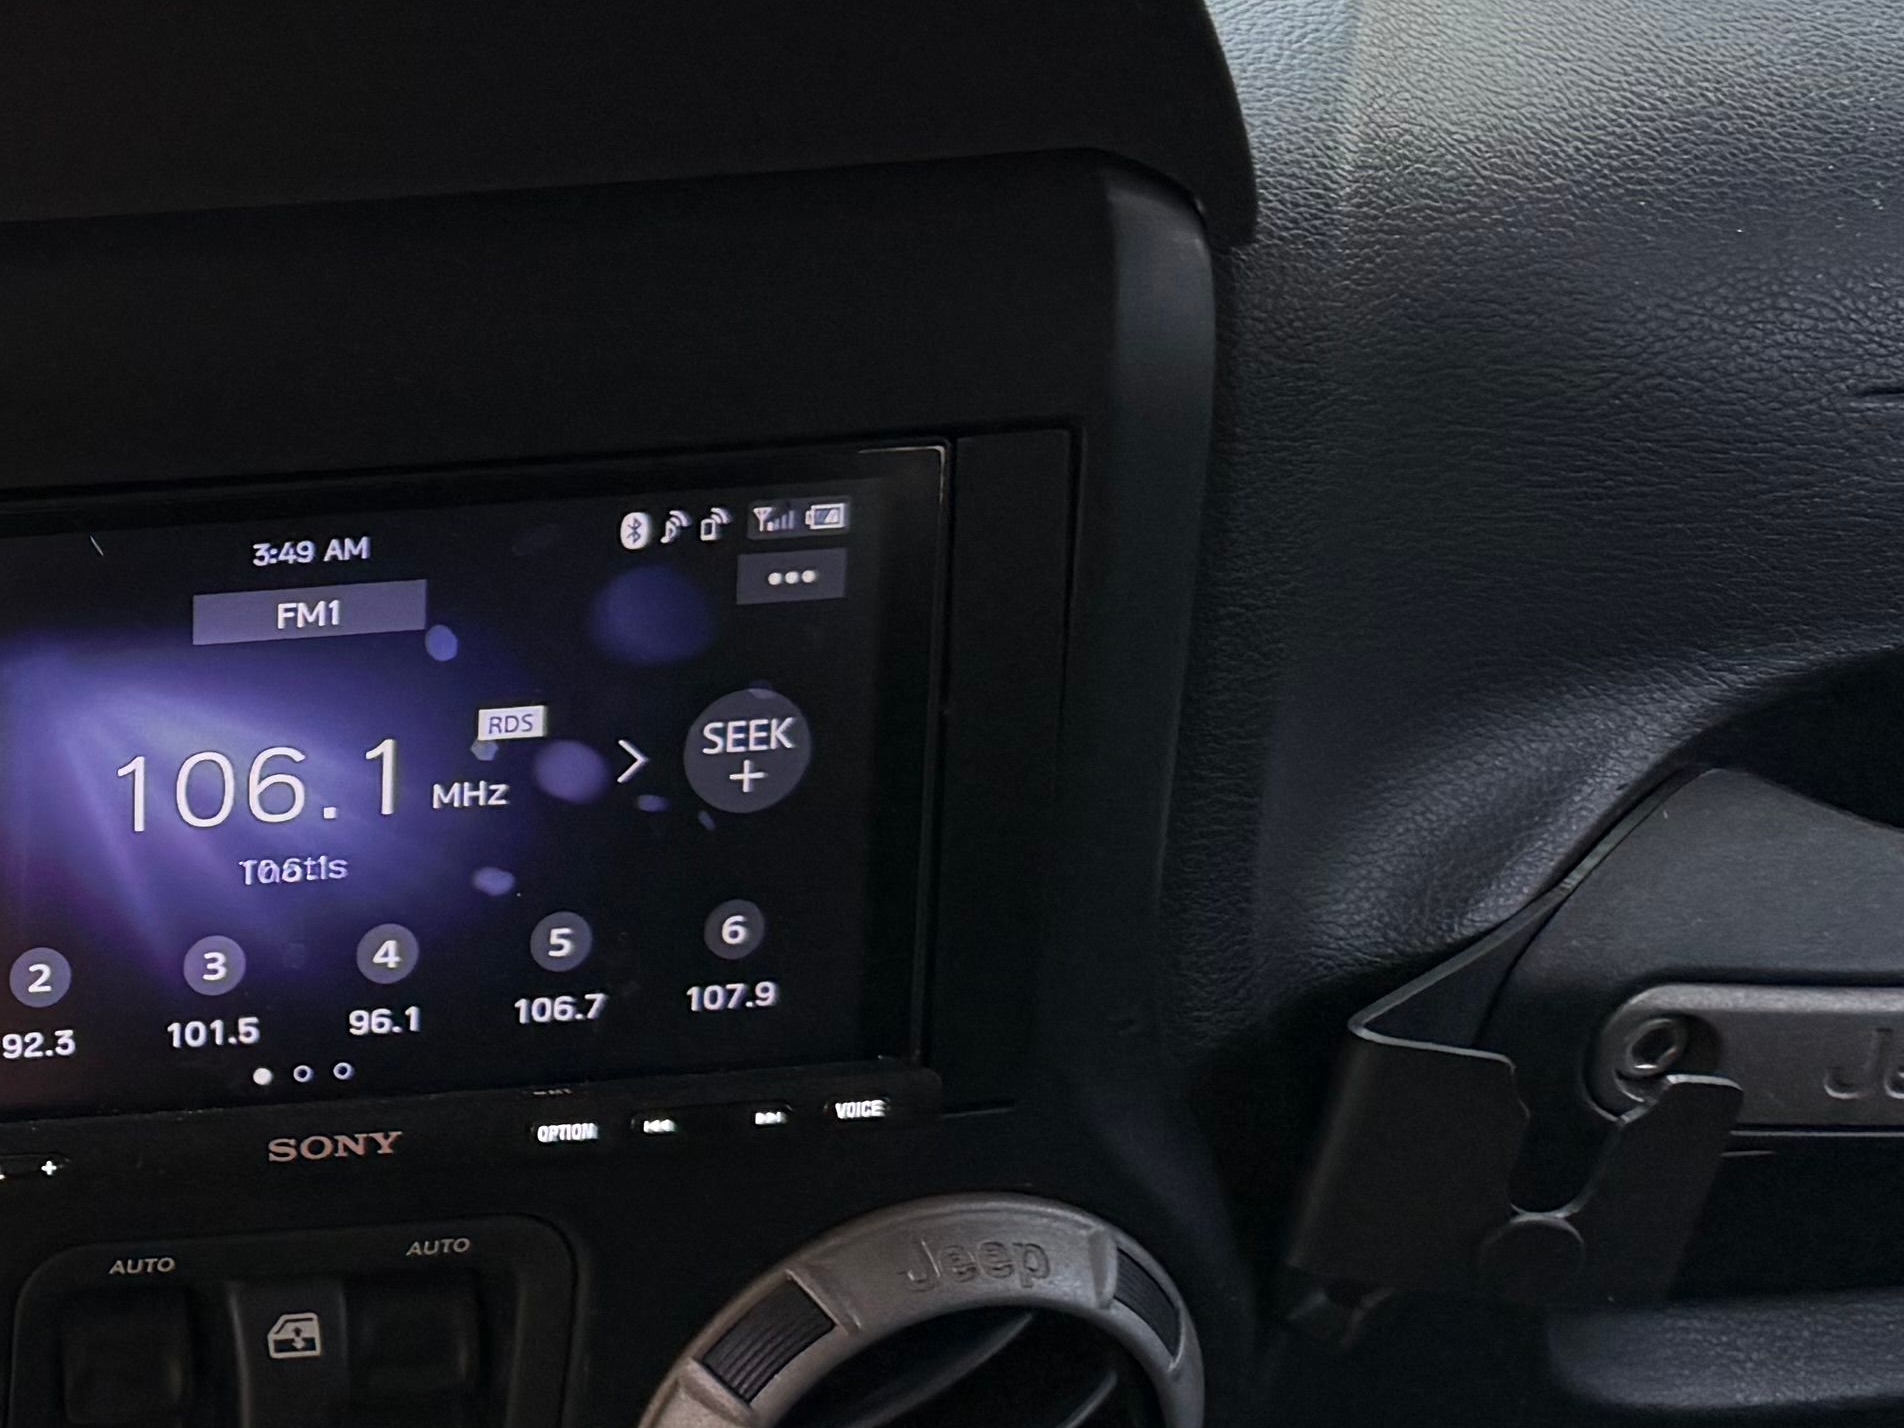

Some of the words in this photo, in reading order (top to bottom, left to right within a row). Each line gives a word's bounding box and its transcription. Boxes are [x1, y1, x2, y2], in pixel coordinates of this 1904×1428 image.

[253, 540, 314, 567] 3:49
[323, 537, 370, 561] AM
[278, 600, 340, 630] FM1
[488, 714, 534, 734] RDS
[702, 717, 798, 755] SEEK
[117, 738, 398, 833] 106.1
[432, 781, 510, 809] MHz
[548, 928, 574, 957] 5
[721, 915, 748, 945] 6
[202, 951, 228, 981] 3
[372, 939, 402, 968] 4
[28, 963, 52, 993] 2
[514, 992, 607, 1024] 106.7
[685, 980, 778, 1012] 107.9
[166, 1016, 261, 1048] 101.5
[349, 1005, 422, 1036] 96.1
[1, 1029, 77, 1060] 92.3
[835, 1099, 884, 1119] VOICE
[268, 1130, 403, 1163] SONY
[537, 1122, 597, 1143] OPTION
[405, 1236, 471, 1257] AUTO
[108, 1256, 176, 1275] AUTO
[900, 1236, 1052, 1292] Jeep
